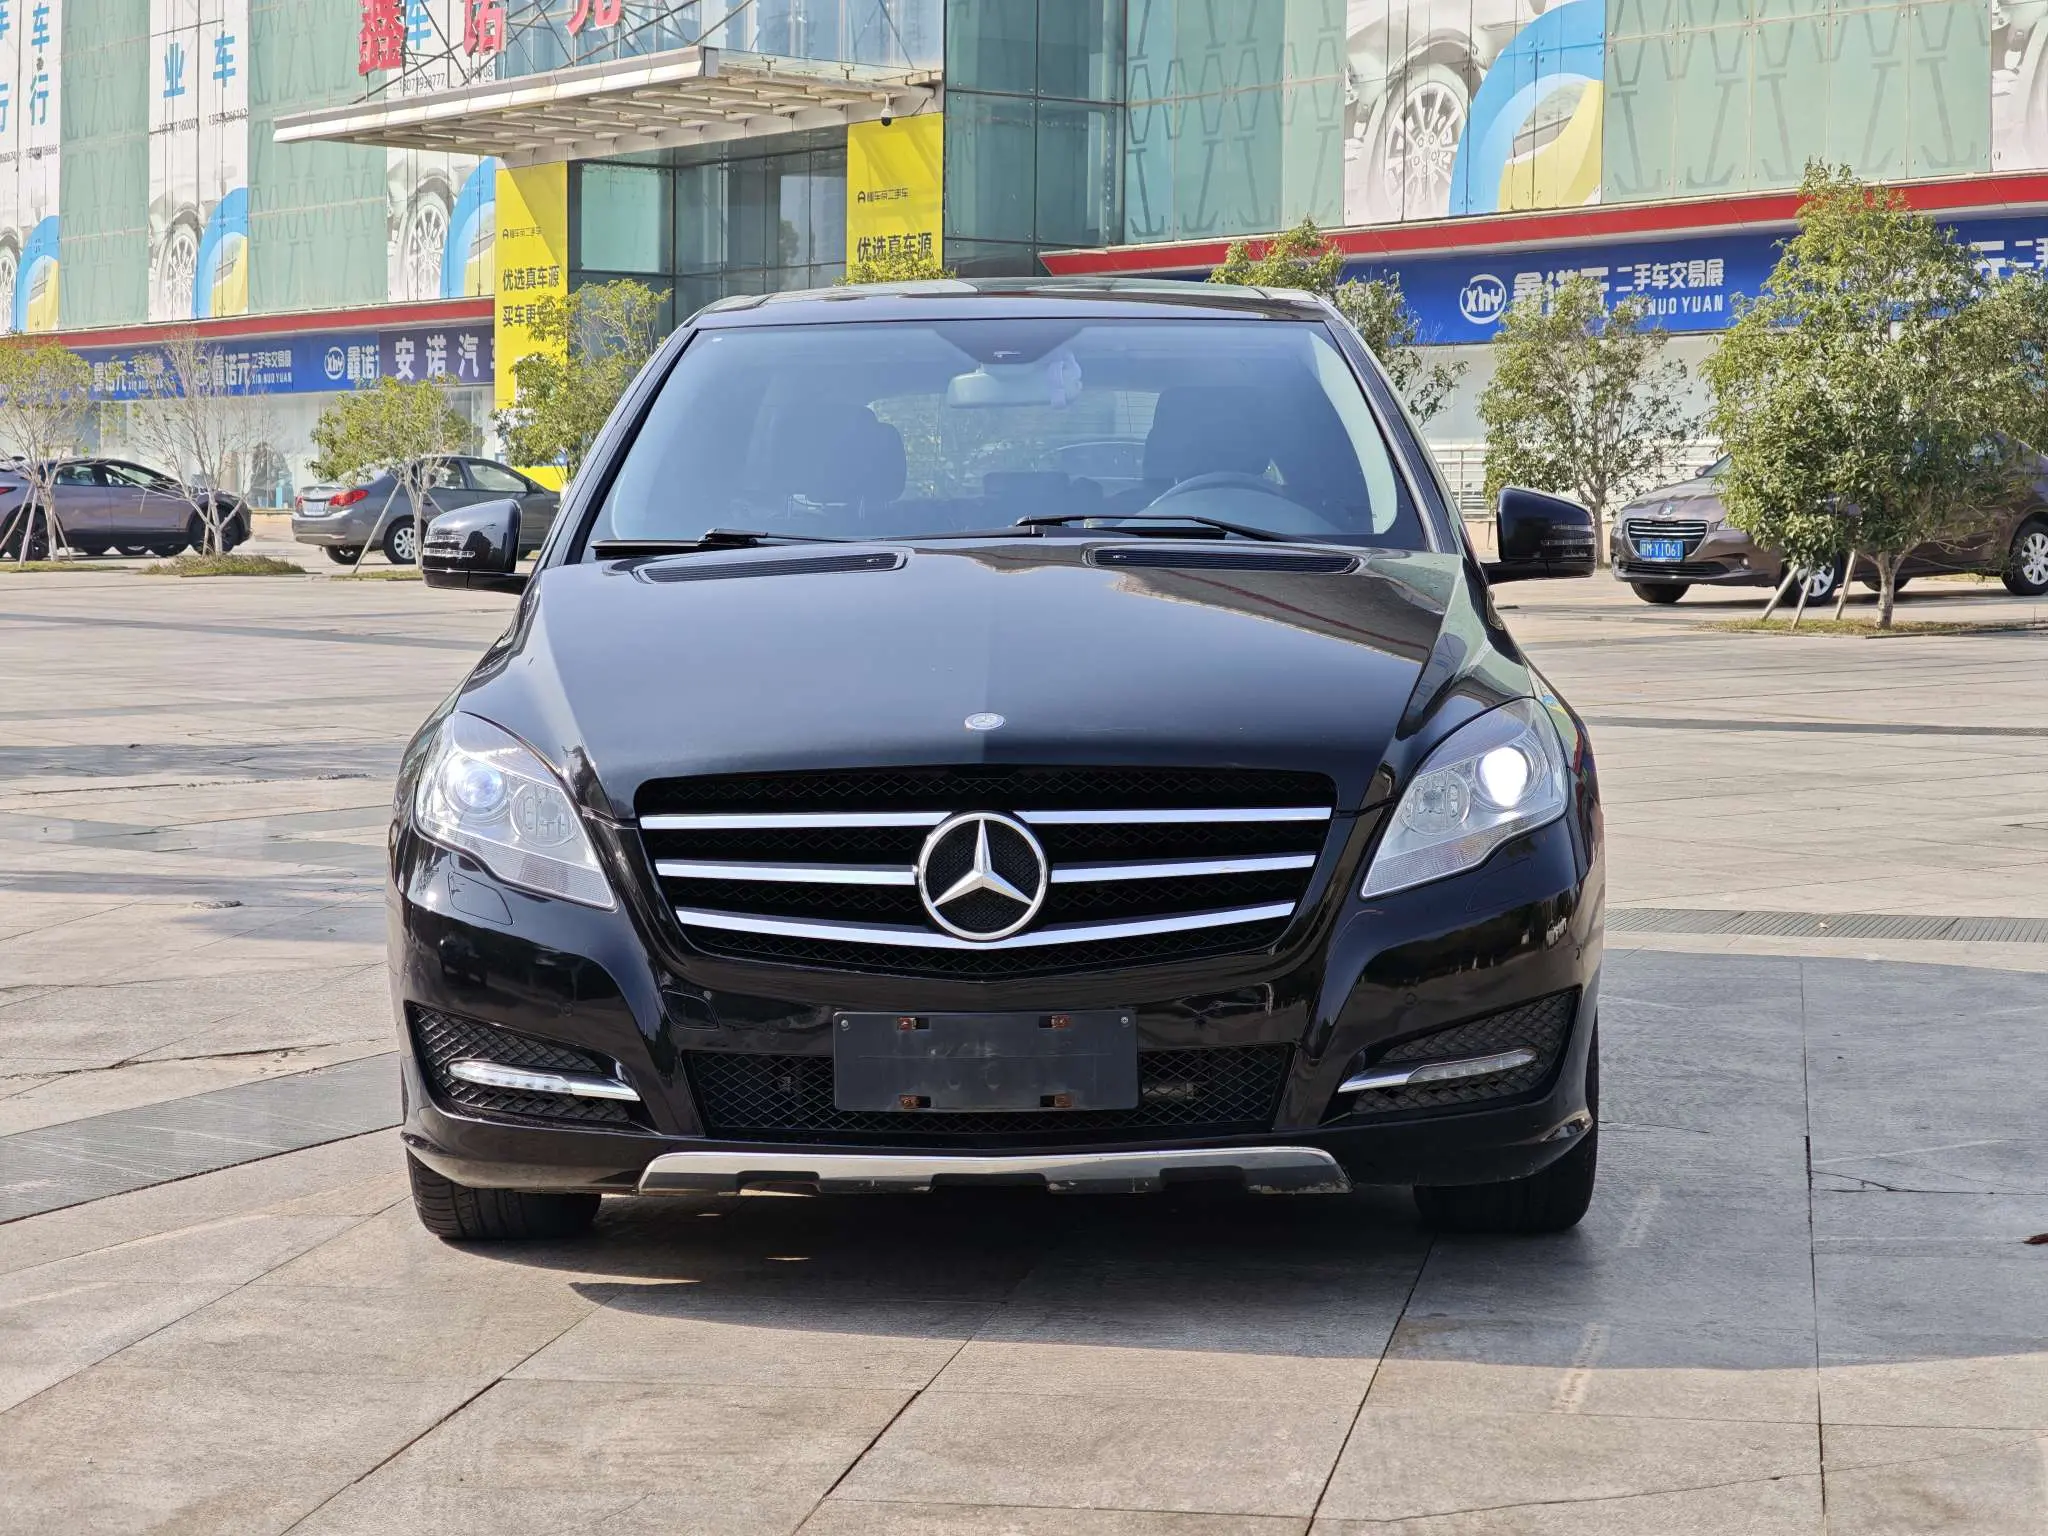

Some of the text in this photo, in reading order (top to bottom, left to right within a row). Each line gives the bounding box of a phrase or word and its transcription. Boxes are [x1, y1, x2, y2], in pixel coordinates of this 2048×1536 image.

[213, 31, 236, 88] 车
[503, 265, 560, 292] 优选真车源
[1616, 258, 1724, 293] 二手车交易展
[1682, 294, 1724, 314] YUAN
[395, 334, 496, 381] 安诺汽
